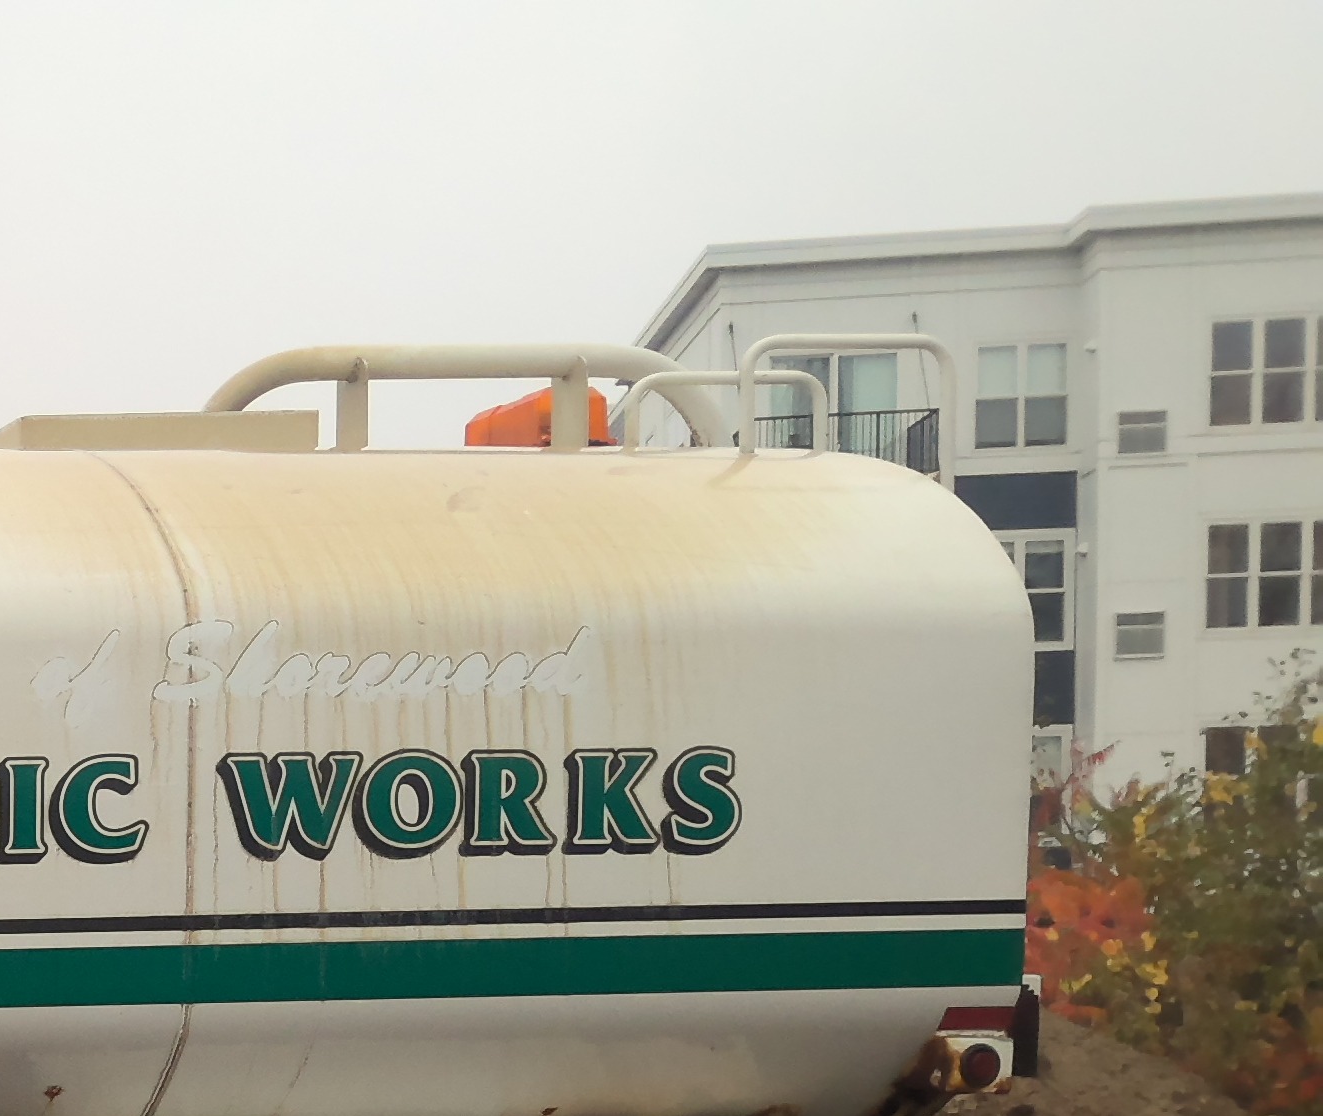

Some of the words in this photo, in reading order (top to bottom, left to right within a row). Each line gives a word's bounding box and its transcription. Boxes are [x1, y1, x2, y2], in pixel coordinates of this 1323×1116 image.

[30, 628, 121, 729] of
[152, 619, 591, 702] Shorewood
[216, 746, 743, 861] WORKS
